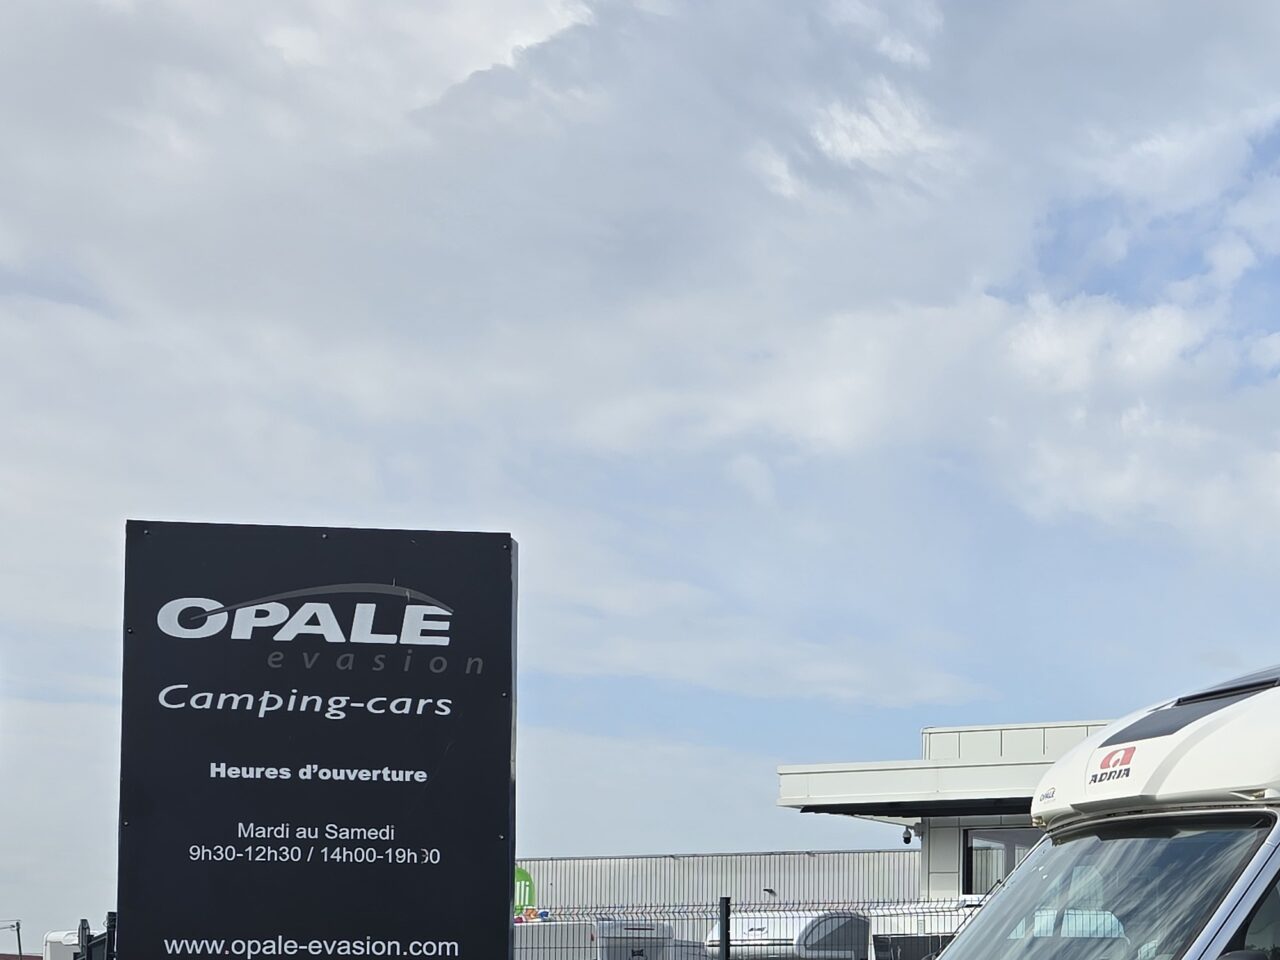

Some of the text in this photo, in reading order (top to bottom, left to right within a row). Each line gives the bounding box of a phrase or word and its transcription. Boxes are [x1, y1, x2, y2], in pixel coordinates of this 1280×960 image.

[157, 597, 453, 646] OPALE
[267, 648, 484, 674] evasion
[158, 684, 453, 720] Camping-cars
[209, 762, 428, 783] Heures d'ouverture
[1088, 767, 1131, 784] ADRIA
[237, 822, 395, 841] Mardi au Samedi
[188, 845, 302, 862] 9h30-12h30
[163, 934, 459, 960] www.opale-evasion.com
